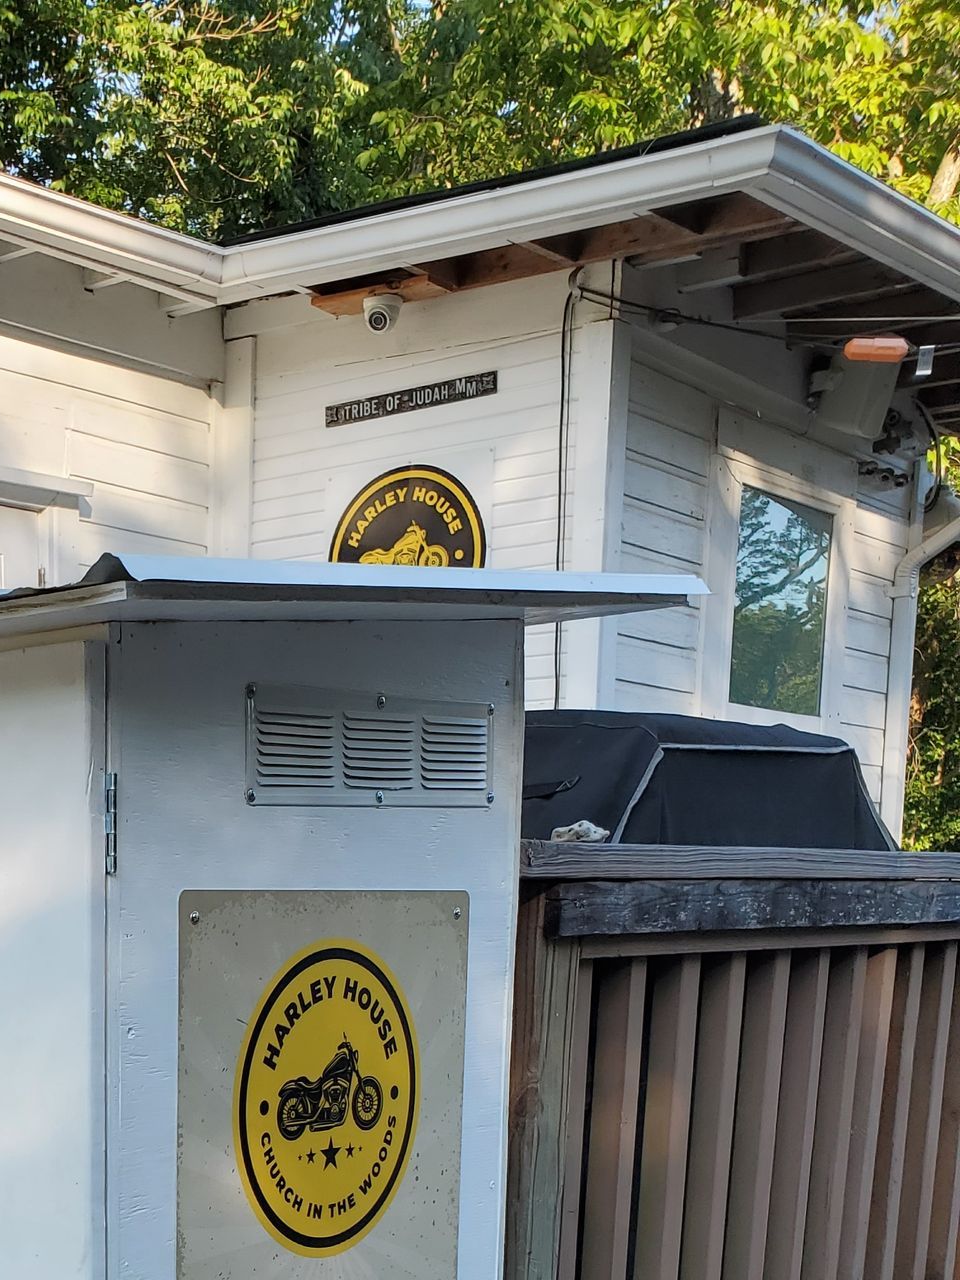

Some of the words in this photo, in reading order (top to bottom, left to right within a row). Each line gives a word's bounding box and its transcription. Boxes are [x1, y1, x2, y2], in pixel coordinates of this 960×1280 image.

[344, 399, 379, 420] TRIBE
[385, 394, 402, 411] OF
[409, 384, 449, 407] JUDAH
[348, 486, 408, 548] HARLEY
[412, 486, 464, 535] HOUSE
[262, 975, 337, 1071] HARLEY
[342, 976, 398, 1060] HOUSE
[261, 1131, 304, 1213] CHURCH
[307, 1203, 323, 1219] IN
[328, 1192, 357, 1219] THE
[358, 1115, 396, 1196] WOODS
